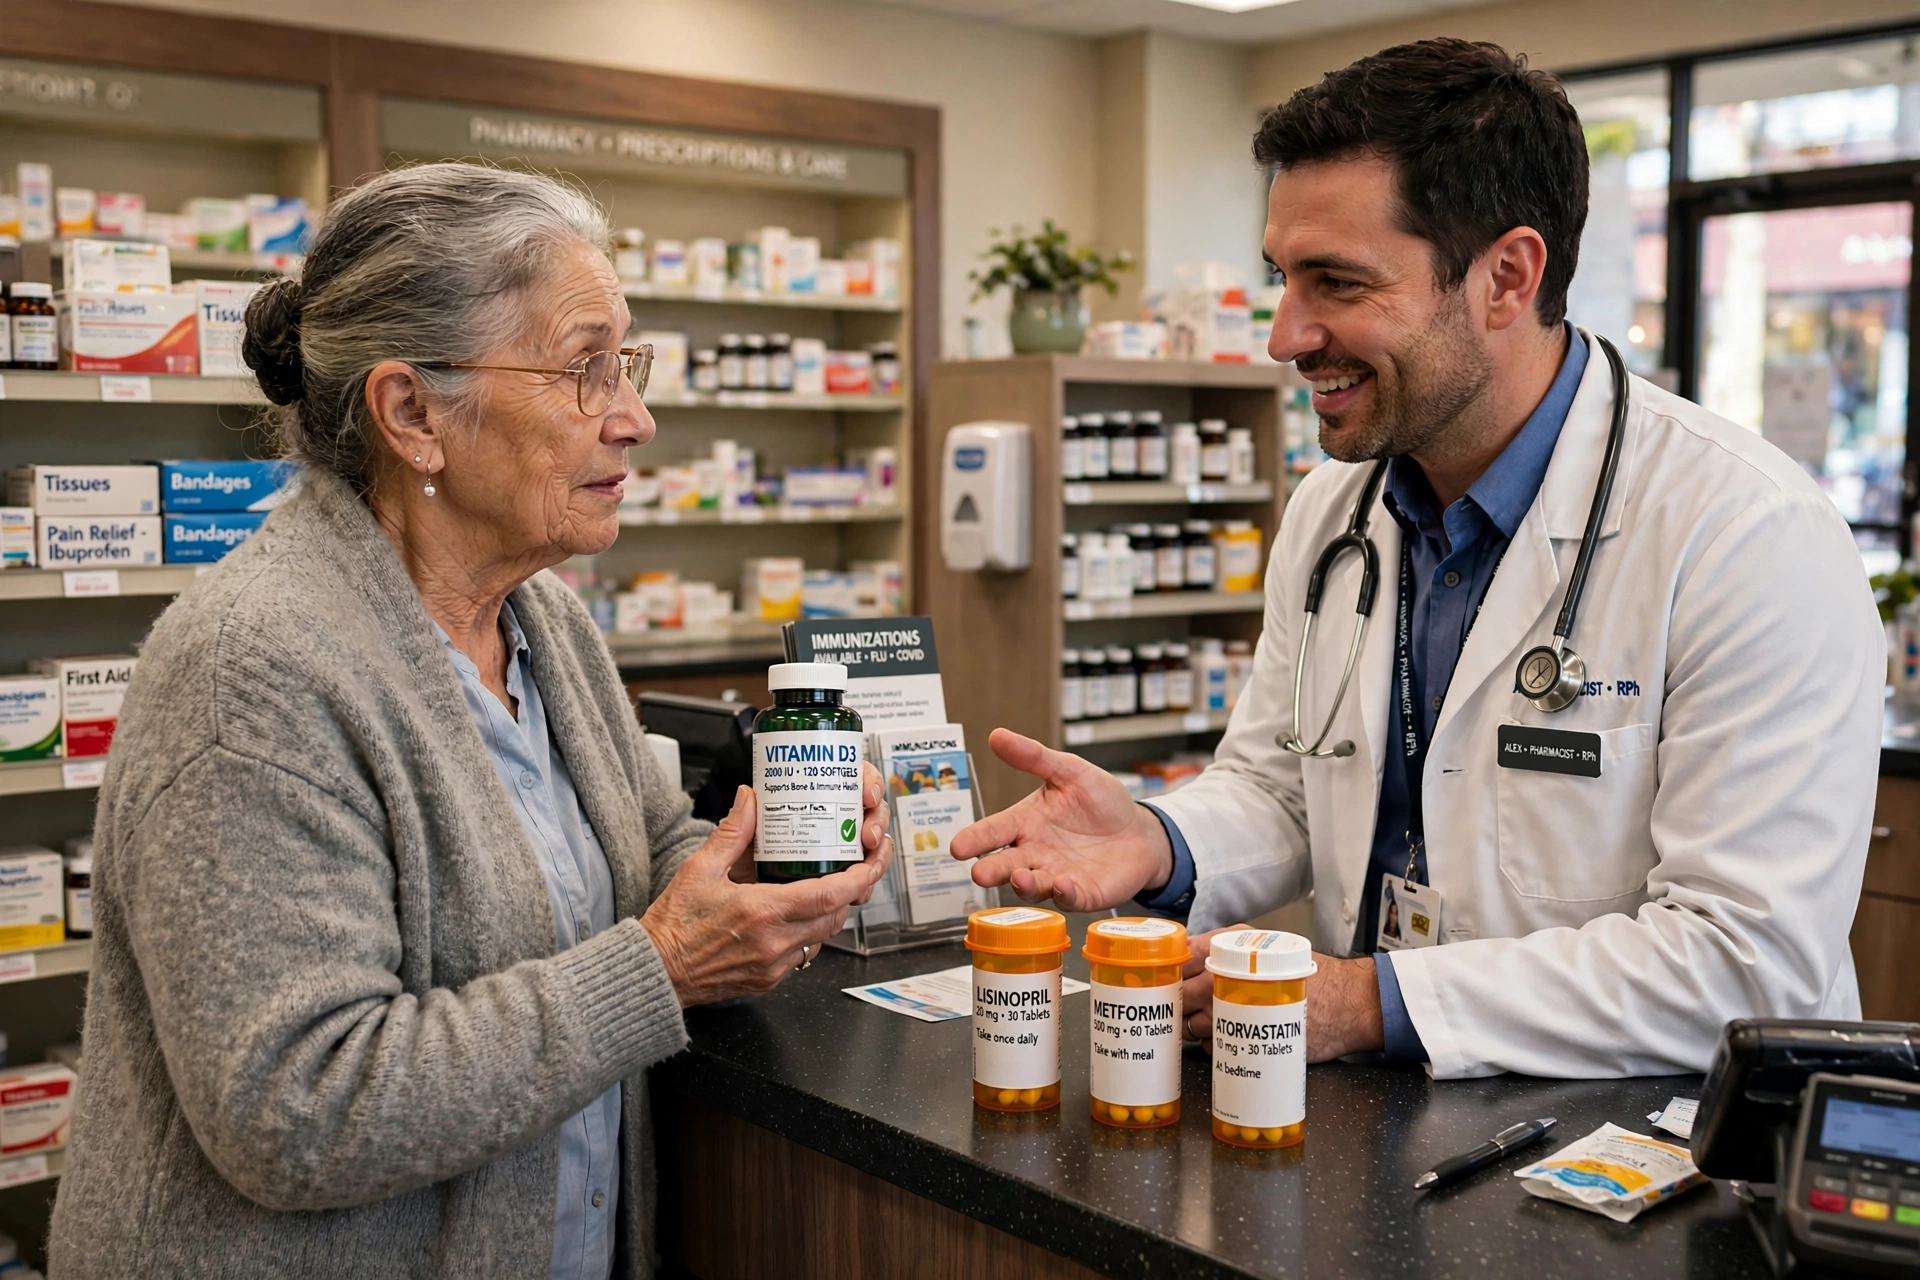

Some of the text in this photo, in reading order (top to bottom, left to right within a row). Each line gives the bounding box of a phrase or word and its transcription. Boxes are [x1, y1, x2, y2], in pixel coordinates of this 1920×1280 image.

[469, 116, 597, 155] PHARMACY
[616, 130, 777, 174] PRESCRIPTIONS
[798, 149, 847, 180] CARE
[44, 474, 110, 492] Tissues
[171, 473, 251, 493] Bandages
[48, 524, 136, 541] Pain Relief
[49, 544, 130, 563] Ibuprofen
[811, 630, 921, 649] IMMUNIZATIONS
[814, 649, 924, 664] AVAILABLE FLU COVID
[67, 667, 131, 685] First Aid
[1617, 680, 1640, 696] RPh
[765, 745, 856, 763] VITAMIN D3
[1504, 742, 1597, 762] ALEX PHARMACIST RPh
[764, 766, 857, 778] 2000 IU 120 SOFTGELS
[764, 782, 790, 793] Supports
[791, 782, 808, 791] Bone
[809, 782, 815, 791] &
[843, 782, 859, 792] Health
[976, 985, 1052, 1007] LISINOPRIL
[976, 1005, 1051, 1023] 20 mg 30 Tablets
[1093, 999, 1174, 1022] METFORMIN
[976, 1026, 1039, 1047] Take once daily
[1093, 1018, 1173, 1038] 500 mg 60 Tablets
[1215, 1017, 1301, 1041] ATORVASTATIN
[1093, 1041, 1154, 1061] Take with meal
[1215, 1036, 1293, 1057] 10 mg 30 Tablets
[1215, 1060, 1262, 1079] At bedtime
